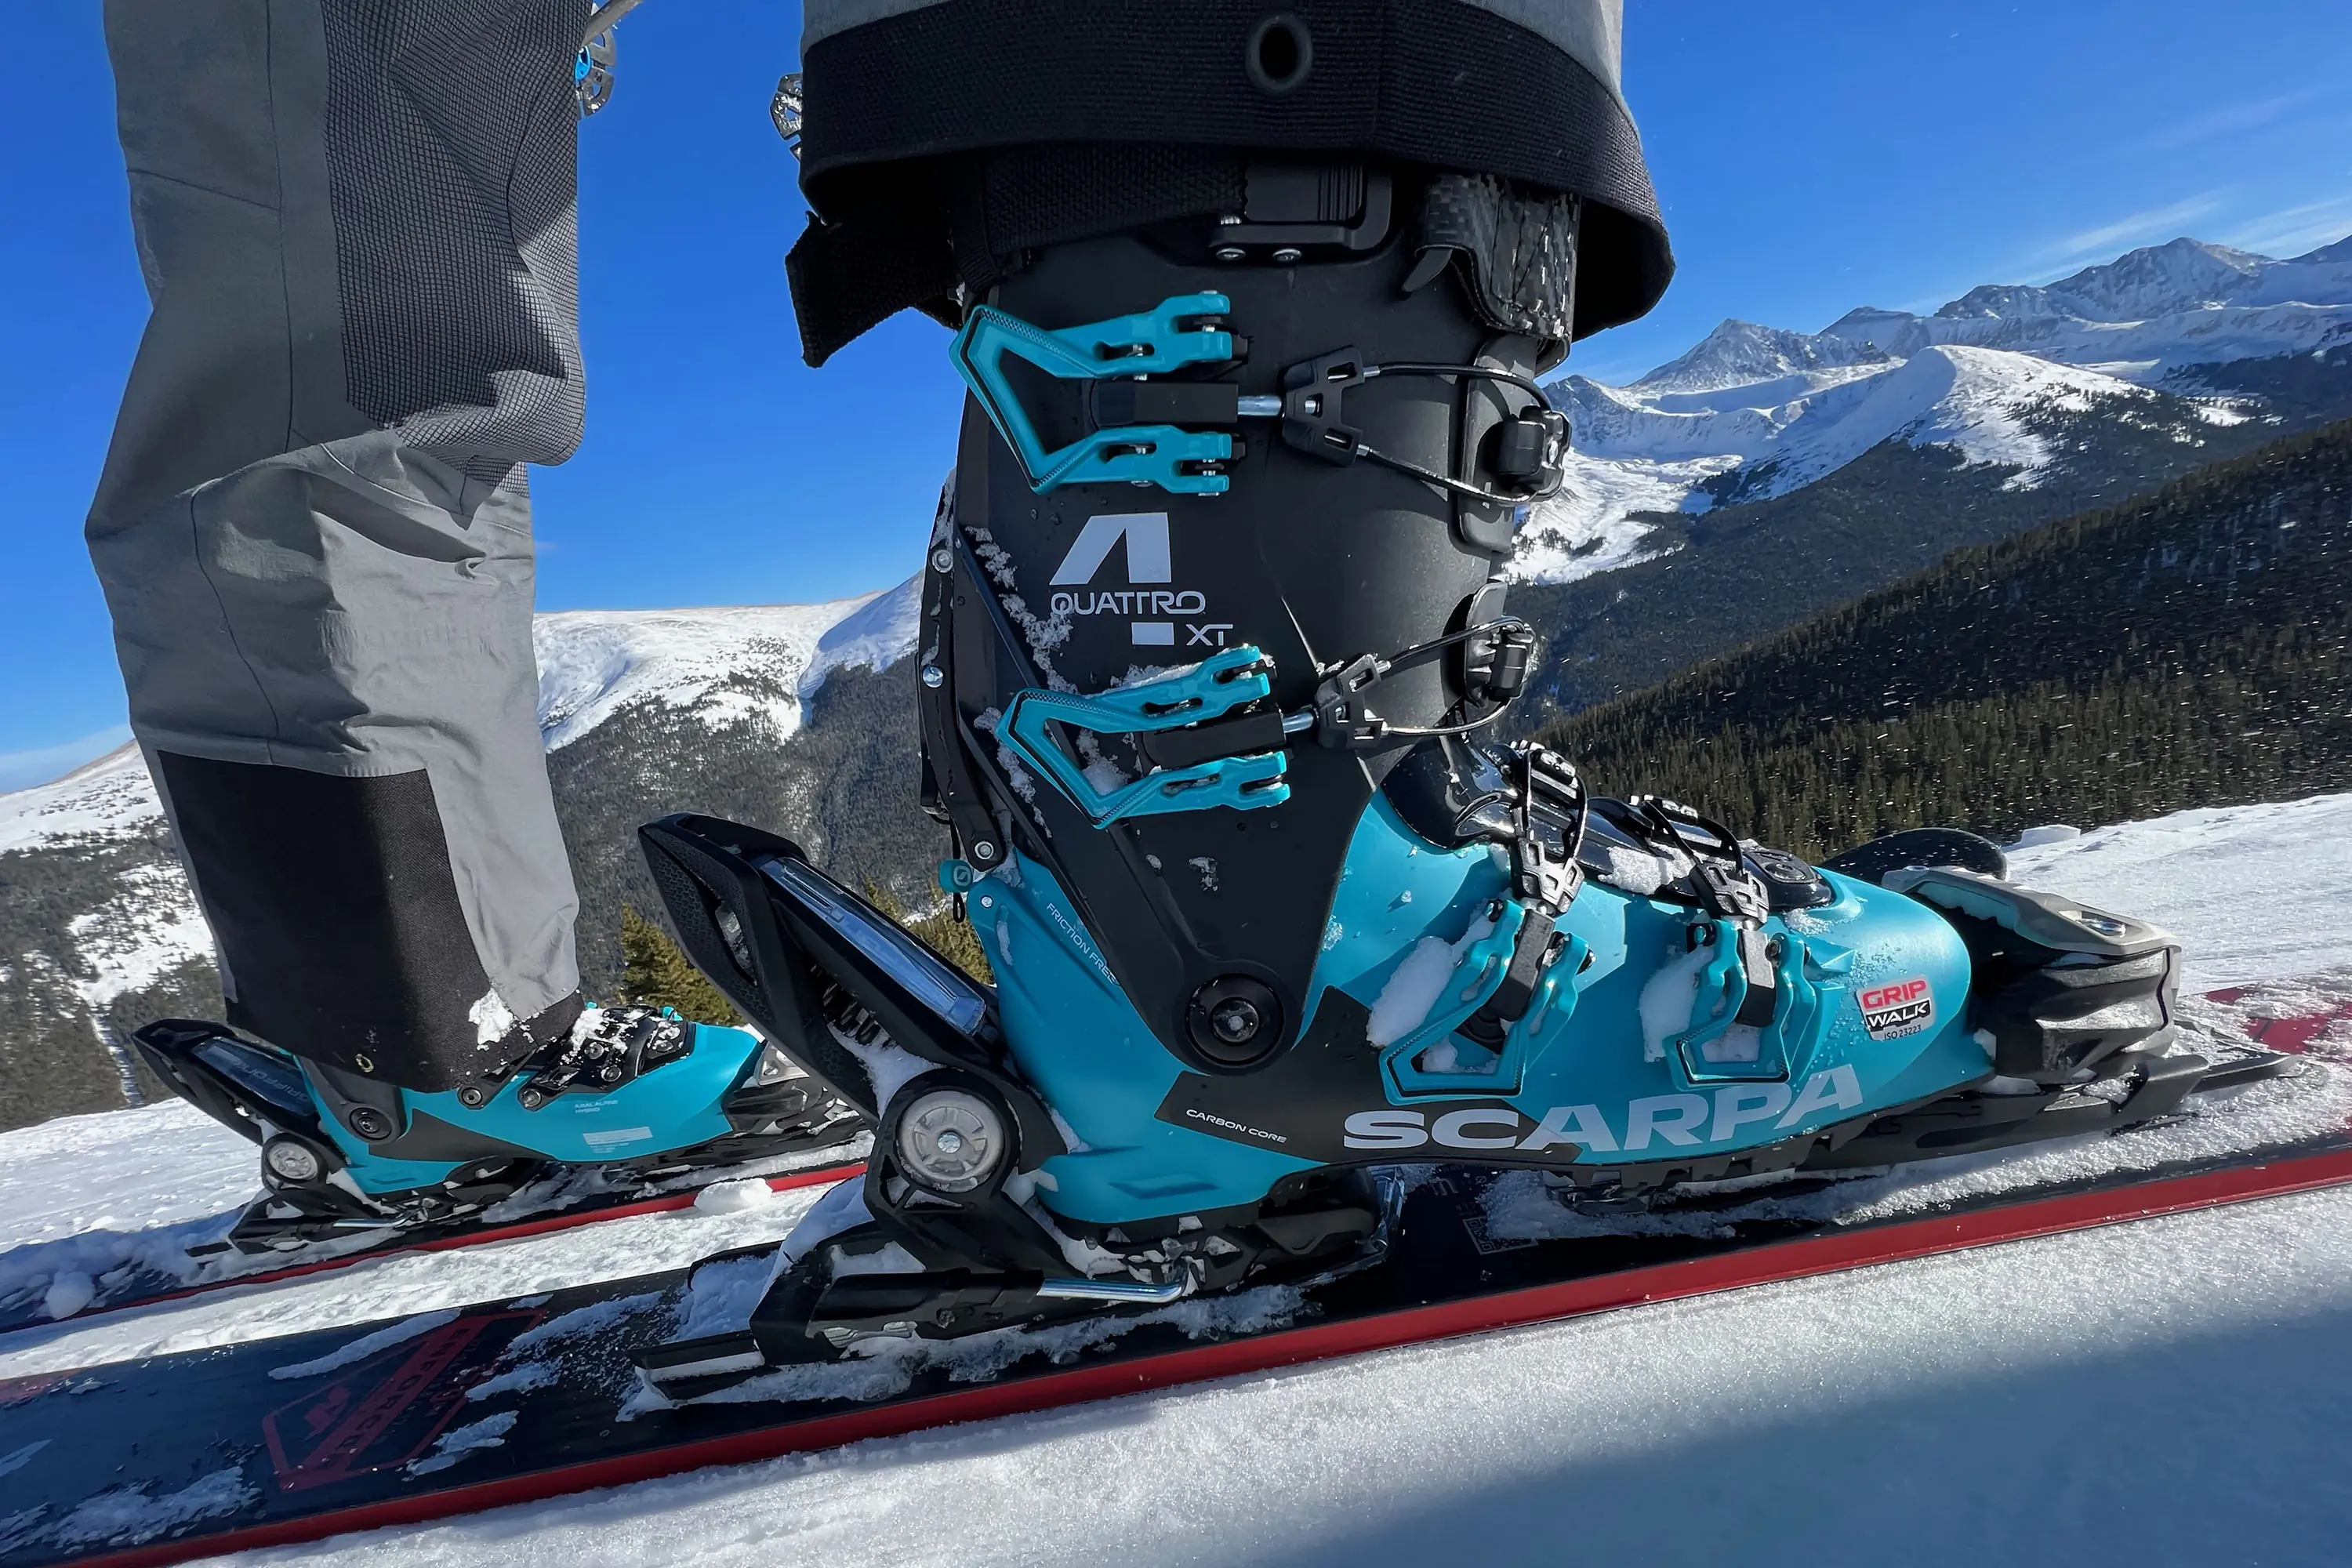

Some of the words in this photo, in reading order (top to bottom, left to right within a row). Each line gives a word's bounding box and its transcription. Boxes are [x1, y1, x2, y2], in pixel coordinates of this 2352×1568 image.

[1051, 590, 1206, 615] QUATTRO
[1185, 623, 1234, 647] XT
[1047, 902, 1091, 954] FRICTION
[1089, 952, 1119, 985] FREE
[1863, 981, 1926, 1009] GRIP
[1867, 1003, 1927, 1028] WALK
[1884, 1029, 1897, 1040] ISO
[1899, 1025, 1922, 1038] 23223
[1344, 1064, 1864, 1152] SCARPA
[1185, 1109, 1247, 1132] CARBON
[1248, 1128, 1287, 1143] CORE
